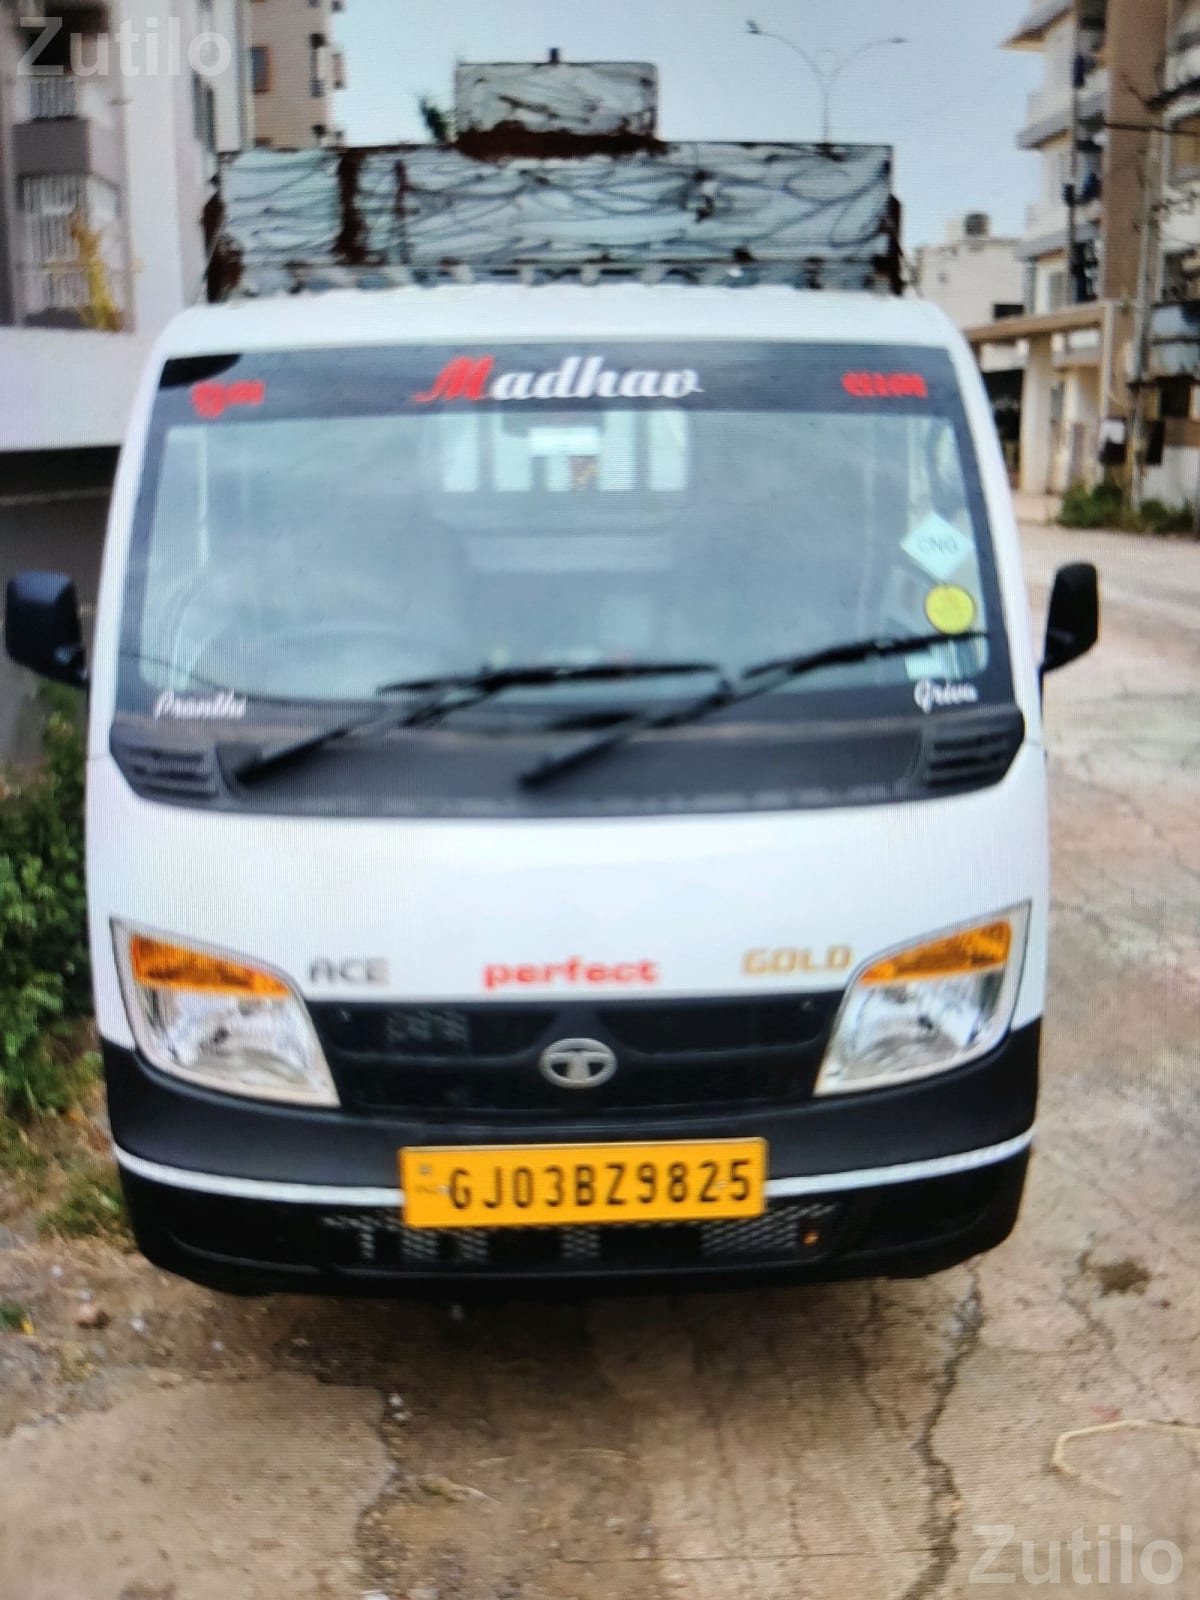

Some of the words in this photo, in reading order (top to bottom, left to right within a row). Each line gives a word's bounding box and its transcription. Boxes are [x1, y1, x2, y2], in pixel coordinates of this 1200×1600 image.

[411, 354, 705, 403] Madhav
[308, 957, 390, 986] ACE
[483, 955, 661, 990] perfect
[742, 944, 853, 976] GOLD
[449, 1157, 752, 1211] GJ03BZ9825
